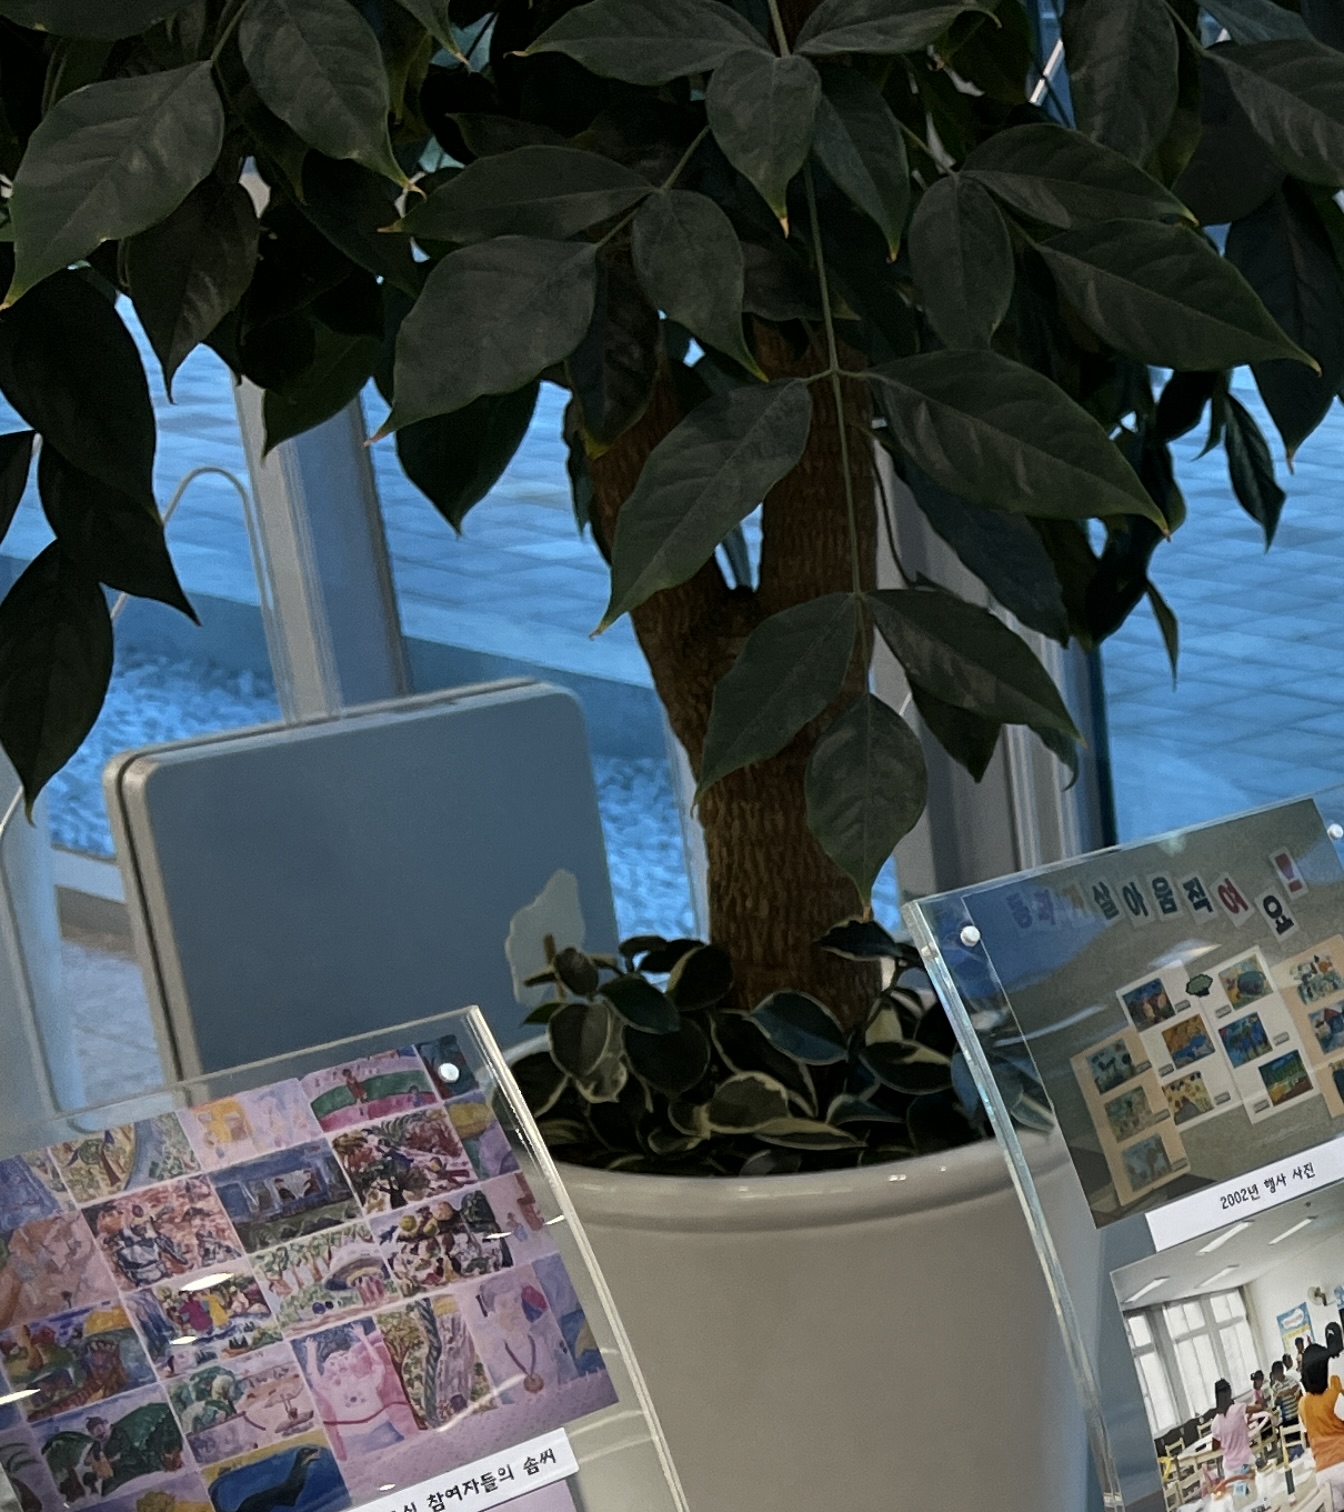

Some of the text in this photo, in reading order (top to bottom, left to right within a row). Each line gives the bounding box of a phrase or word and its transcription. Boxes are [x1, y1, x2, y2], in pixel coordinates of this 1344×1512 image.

[1219, 1161, 1316, 1211] 2002년 행사 사진
[521, 1447, 557, 1475] 솜씨
